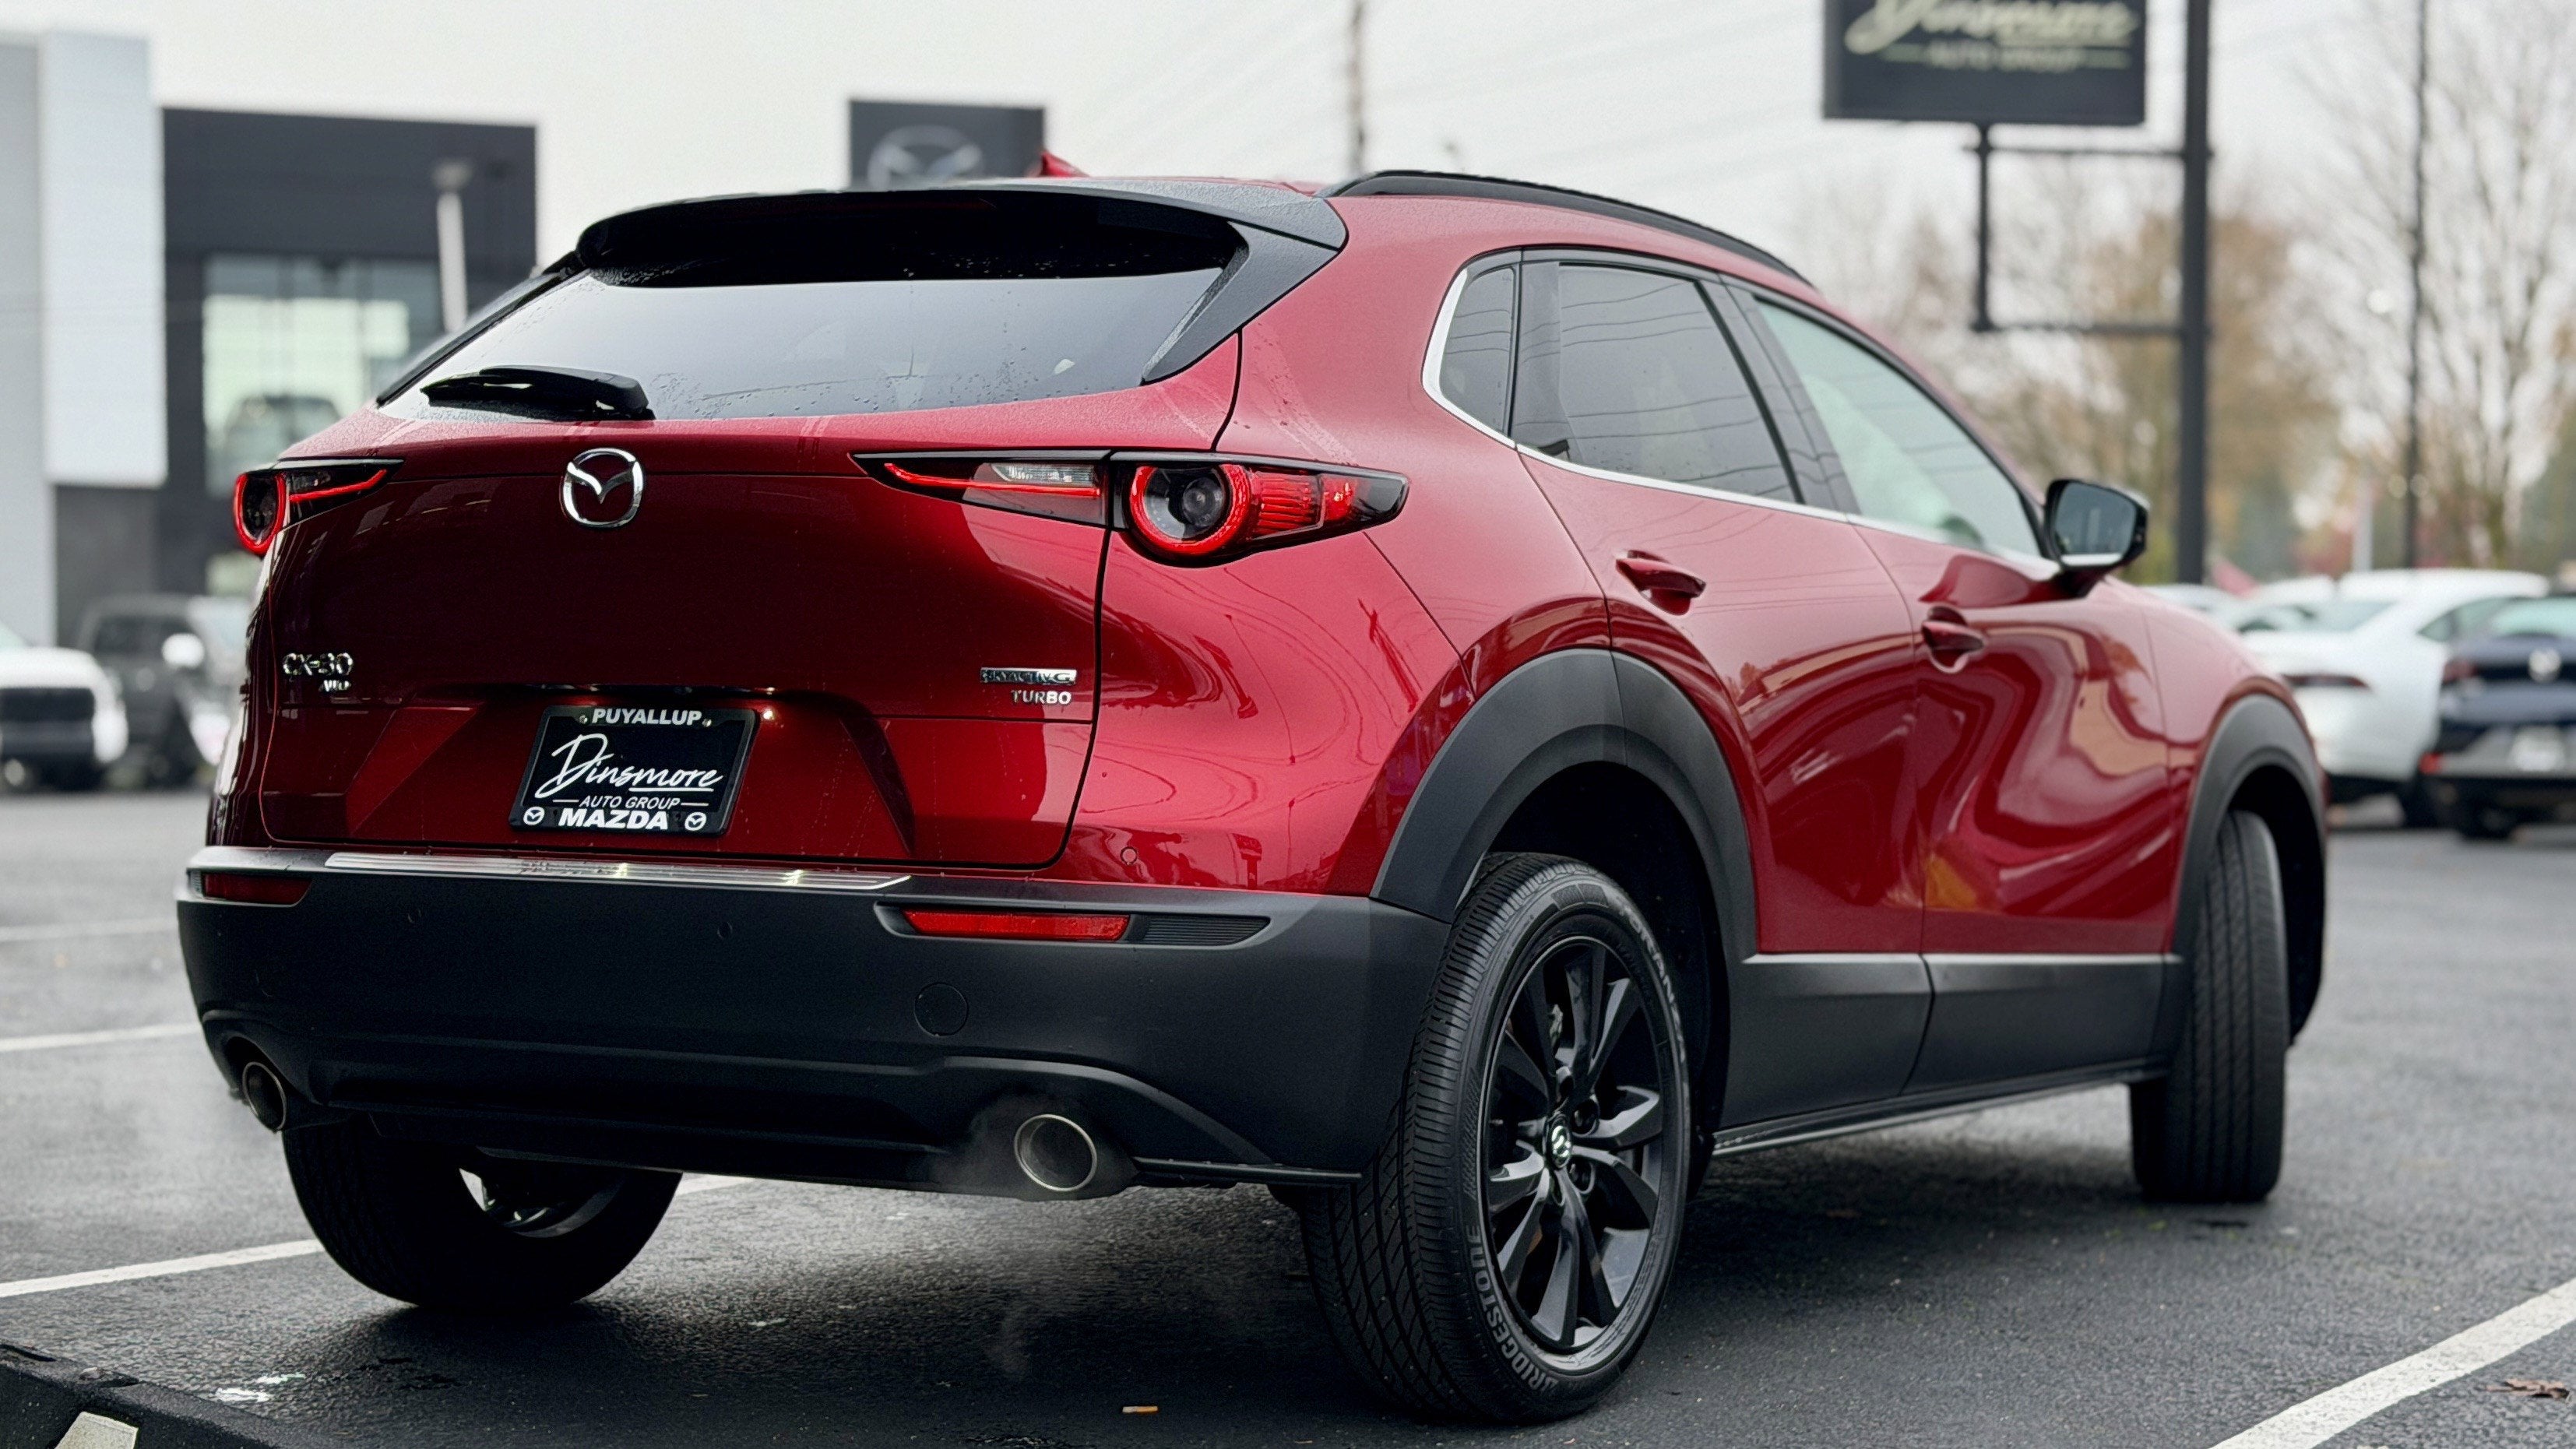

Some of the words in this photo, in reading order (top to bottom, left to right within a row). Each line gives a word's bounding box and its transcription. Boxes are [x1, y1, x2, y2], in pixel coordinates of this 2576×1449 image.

[283, 652, 354, 676] CX-30
[1011, 689, 1072, 705] TURBO
[592, 708, 702, 726] PUYALLUP
[534, 733, 723, 799] Dinsmore
[579, 795, 623, 809] AUTO
[625, 797, 681, 811] GROUP
[558, 807, 669, 831] MAZDA
[1465, 1223, 1560, 1392] BRIDGESTONE
